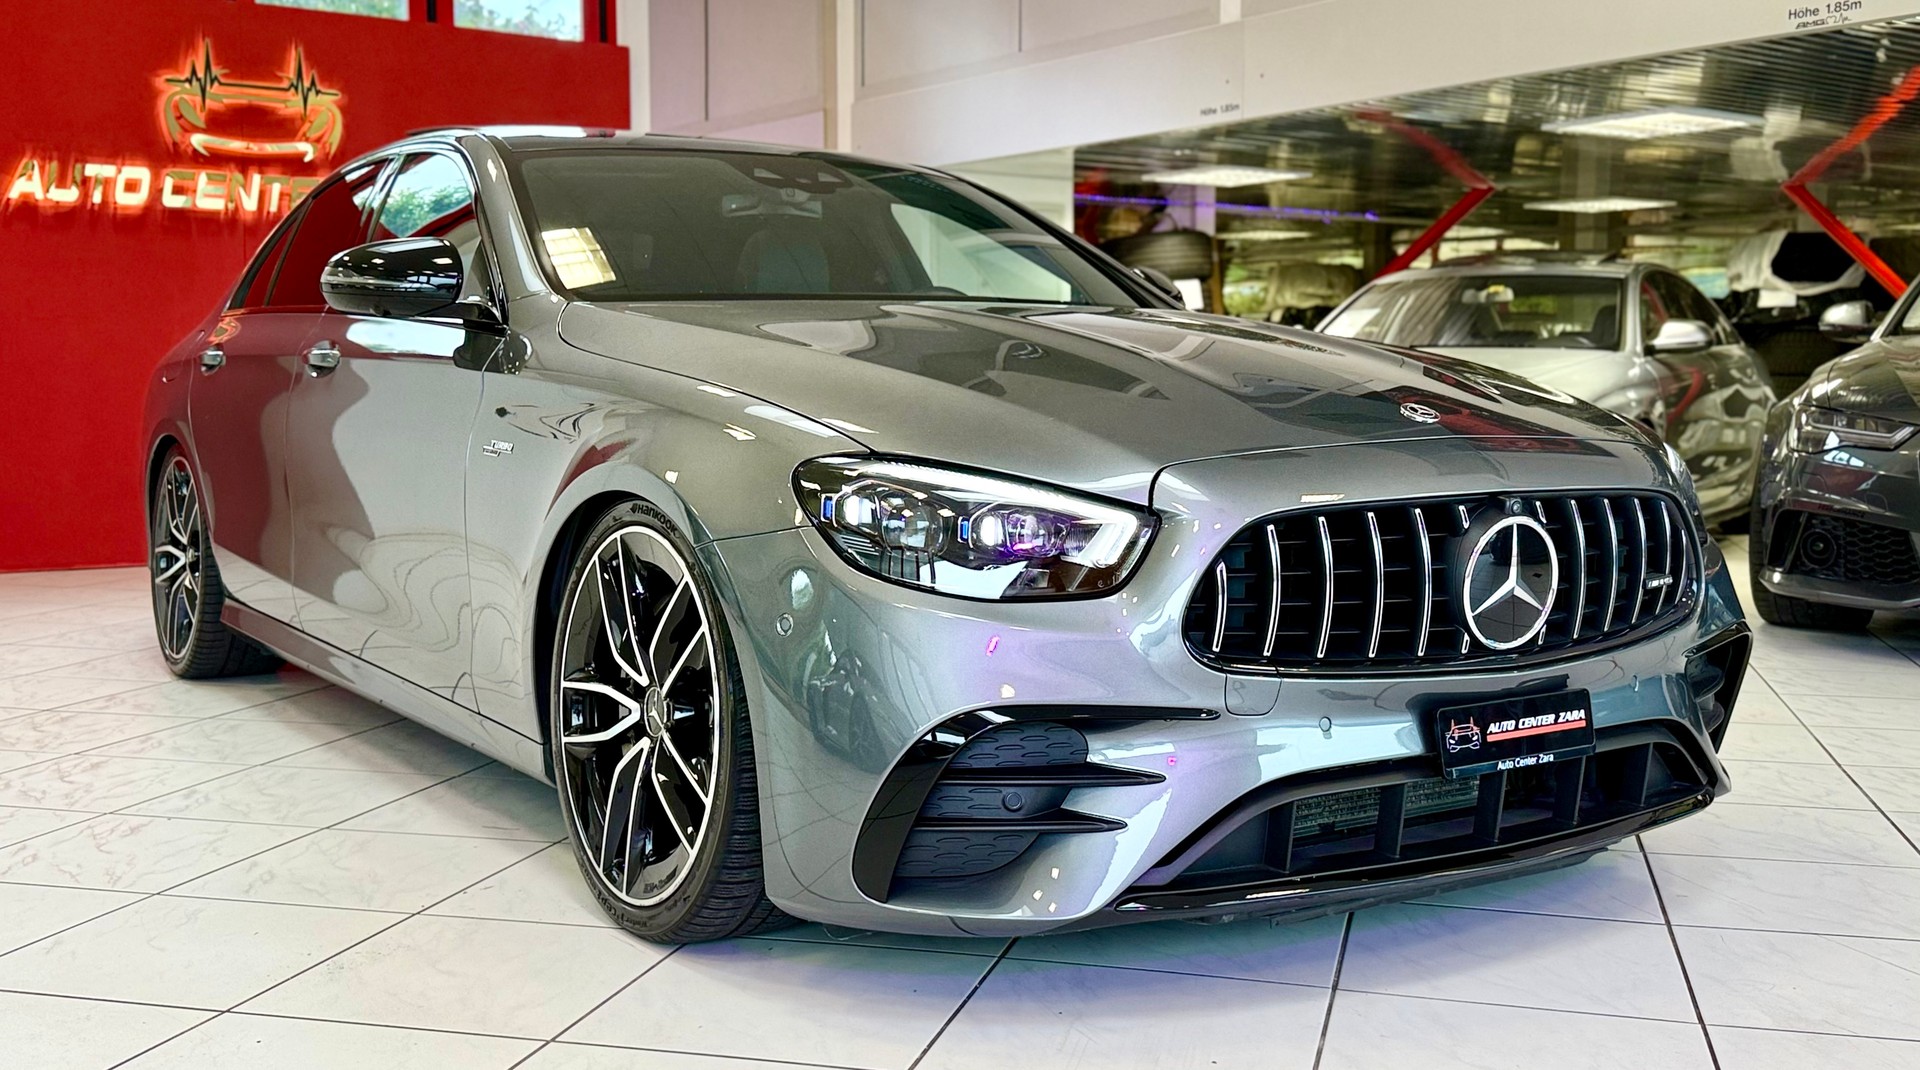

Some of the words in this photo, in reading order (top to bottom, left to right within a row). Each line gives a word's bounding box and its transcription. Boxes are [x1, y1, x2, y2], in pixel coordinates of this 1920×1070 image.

[1788, 6, 1820, 20] Höhe
[1826, 0, 1862, 14] 1.85m
[8, 159, 151, 205] AUTO
[1486, 720, 1516, 734] AUTO
[1518, 713, 1555, 729] CENTER
[1558, 709, 1586, 723] ZARA
[1497, 759, 1514, 771] Auto
[1515, 755, 1538, 768] Center
[1538, 753, 1554, 764] Zara
